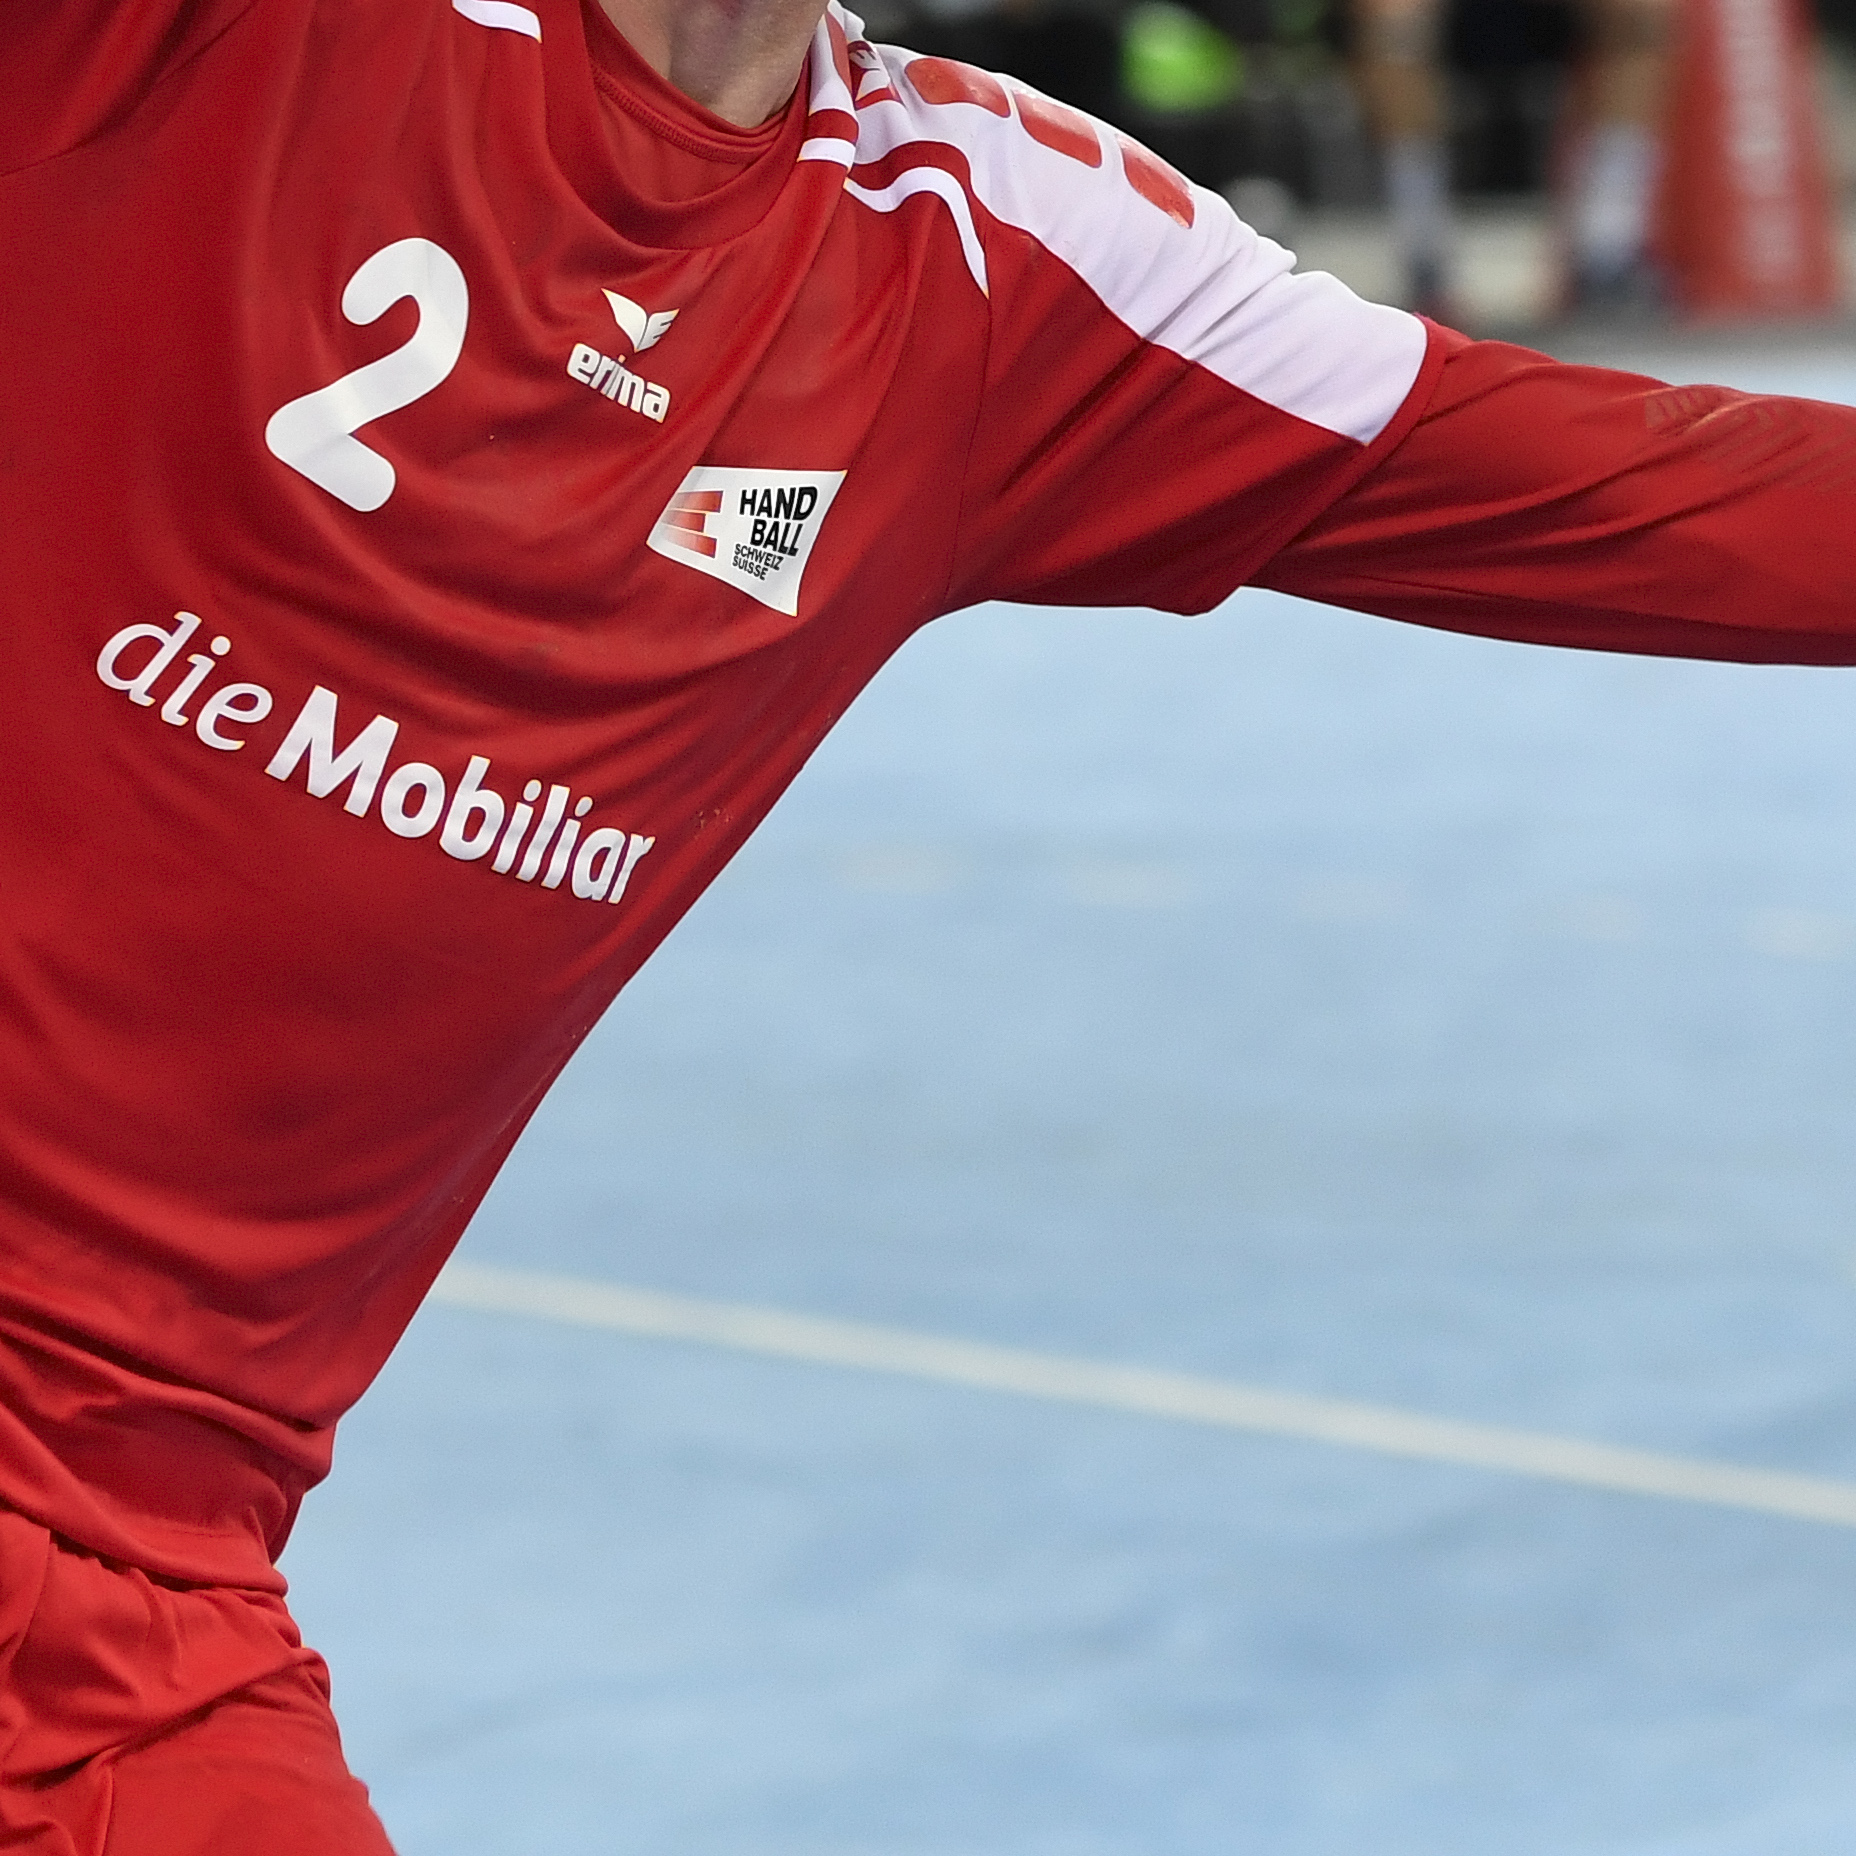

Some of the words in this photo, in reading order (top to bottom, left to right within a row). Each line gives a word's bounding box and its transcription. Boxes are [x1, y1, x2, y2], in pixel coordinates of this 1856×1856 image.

[265, 238, 469, 512] 2
[566, 342, 671, 423] erima
[739, 486, 818, 521] HAND
[750, 519, 803, 556] BALL
[732, 555, 768, 580] SUISSE
[734, 543, 784, 570] SCHWEIZ
[96, 611, 273, 750] die
[264, 684, 655, 904] Mobiliar
